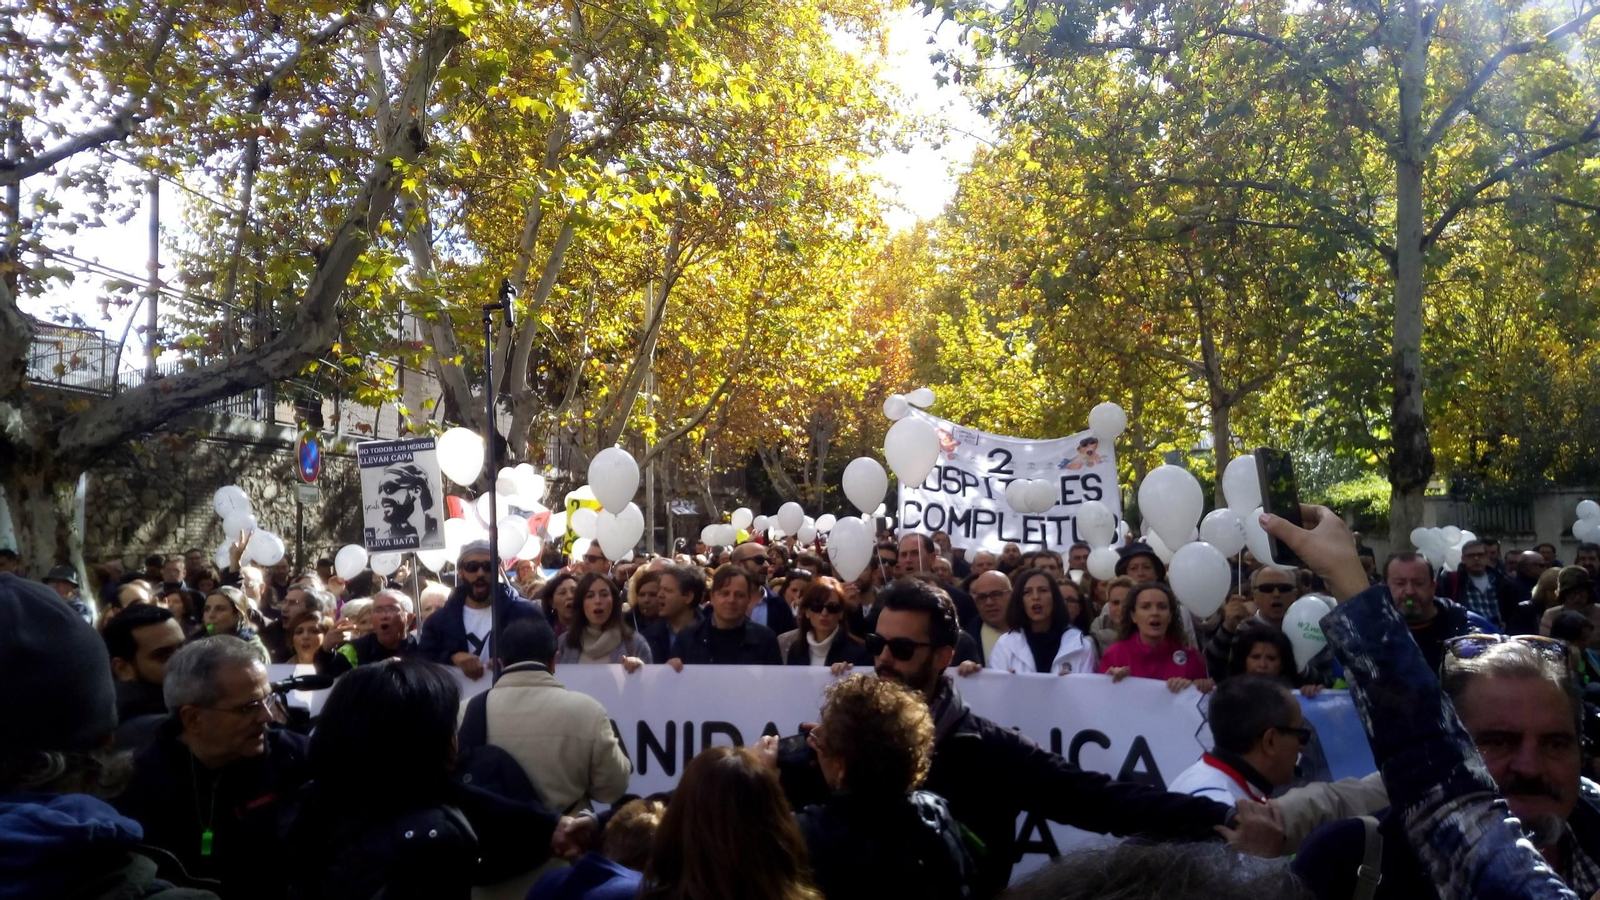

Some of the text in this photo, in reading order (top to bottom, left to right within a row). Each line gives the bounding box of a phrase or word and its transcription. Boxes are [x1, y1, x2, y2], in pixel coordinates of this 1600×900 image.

[370, 446, 394, 454] TODOS
[360, 453, 413, 465] LLEVAN CAPA
[987, 447, 1014, 475] 2
[366, 538, 391, 548] LLEVA
[393, 537, 415, 546] BATA
